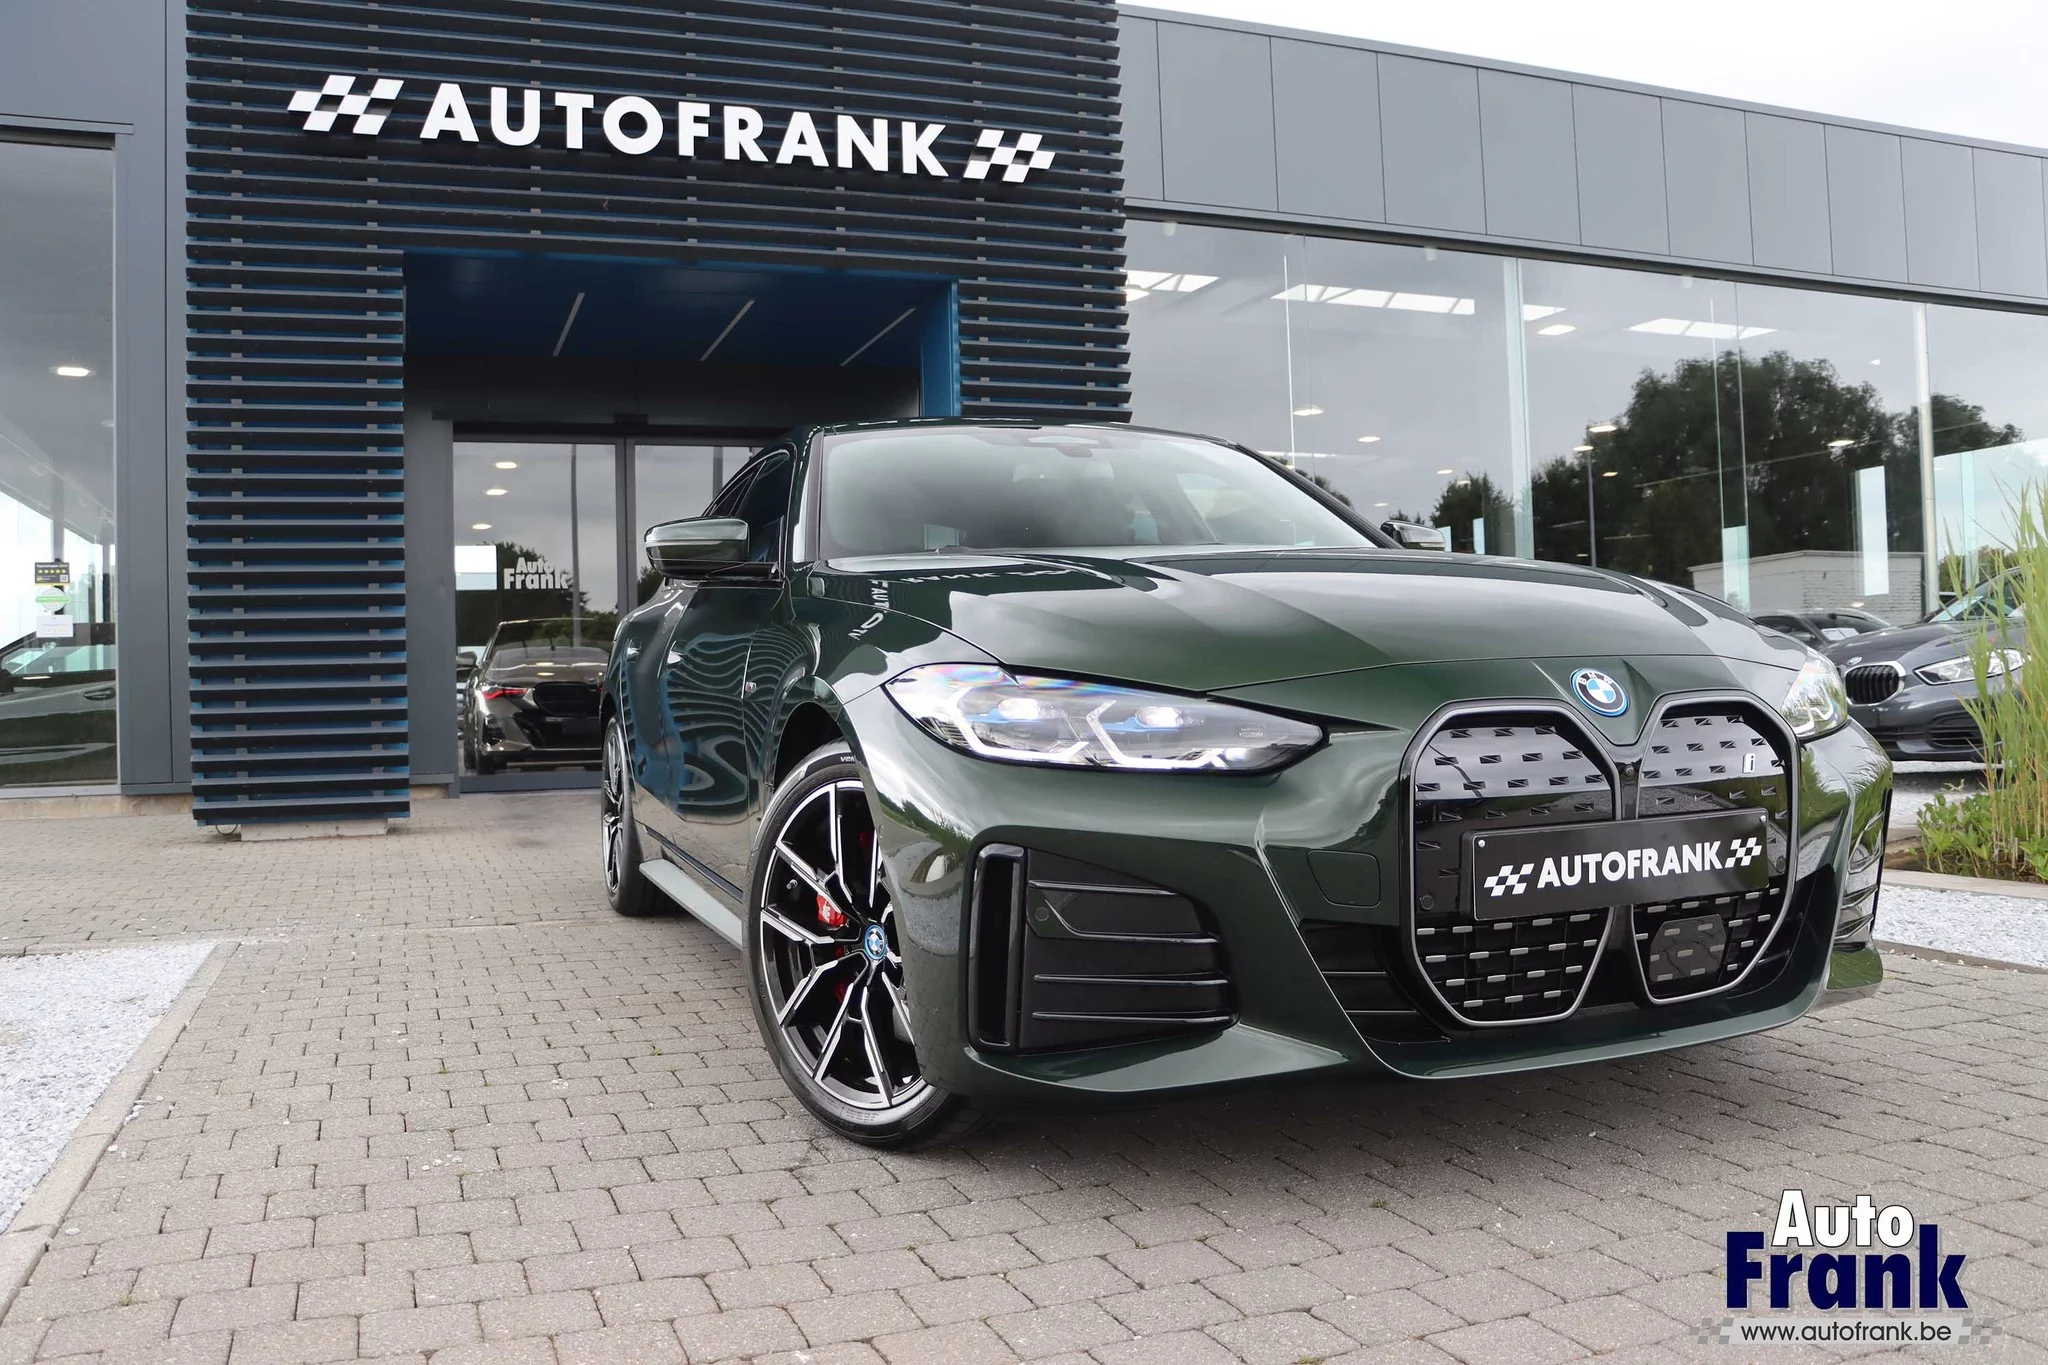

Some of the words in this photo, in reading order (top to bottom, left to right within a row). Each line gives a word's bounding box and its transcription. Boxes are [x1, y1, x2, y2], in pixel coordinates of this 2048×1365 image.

[418, 82, 950, 178] AUTOFRANK
[503, 564, 569, 590] Frank
[516, 557, 555, 574] Auto
[1578, 672, 1613, 685] BMW
[1536, 840, 1723, 889] AUTOFRANK
